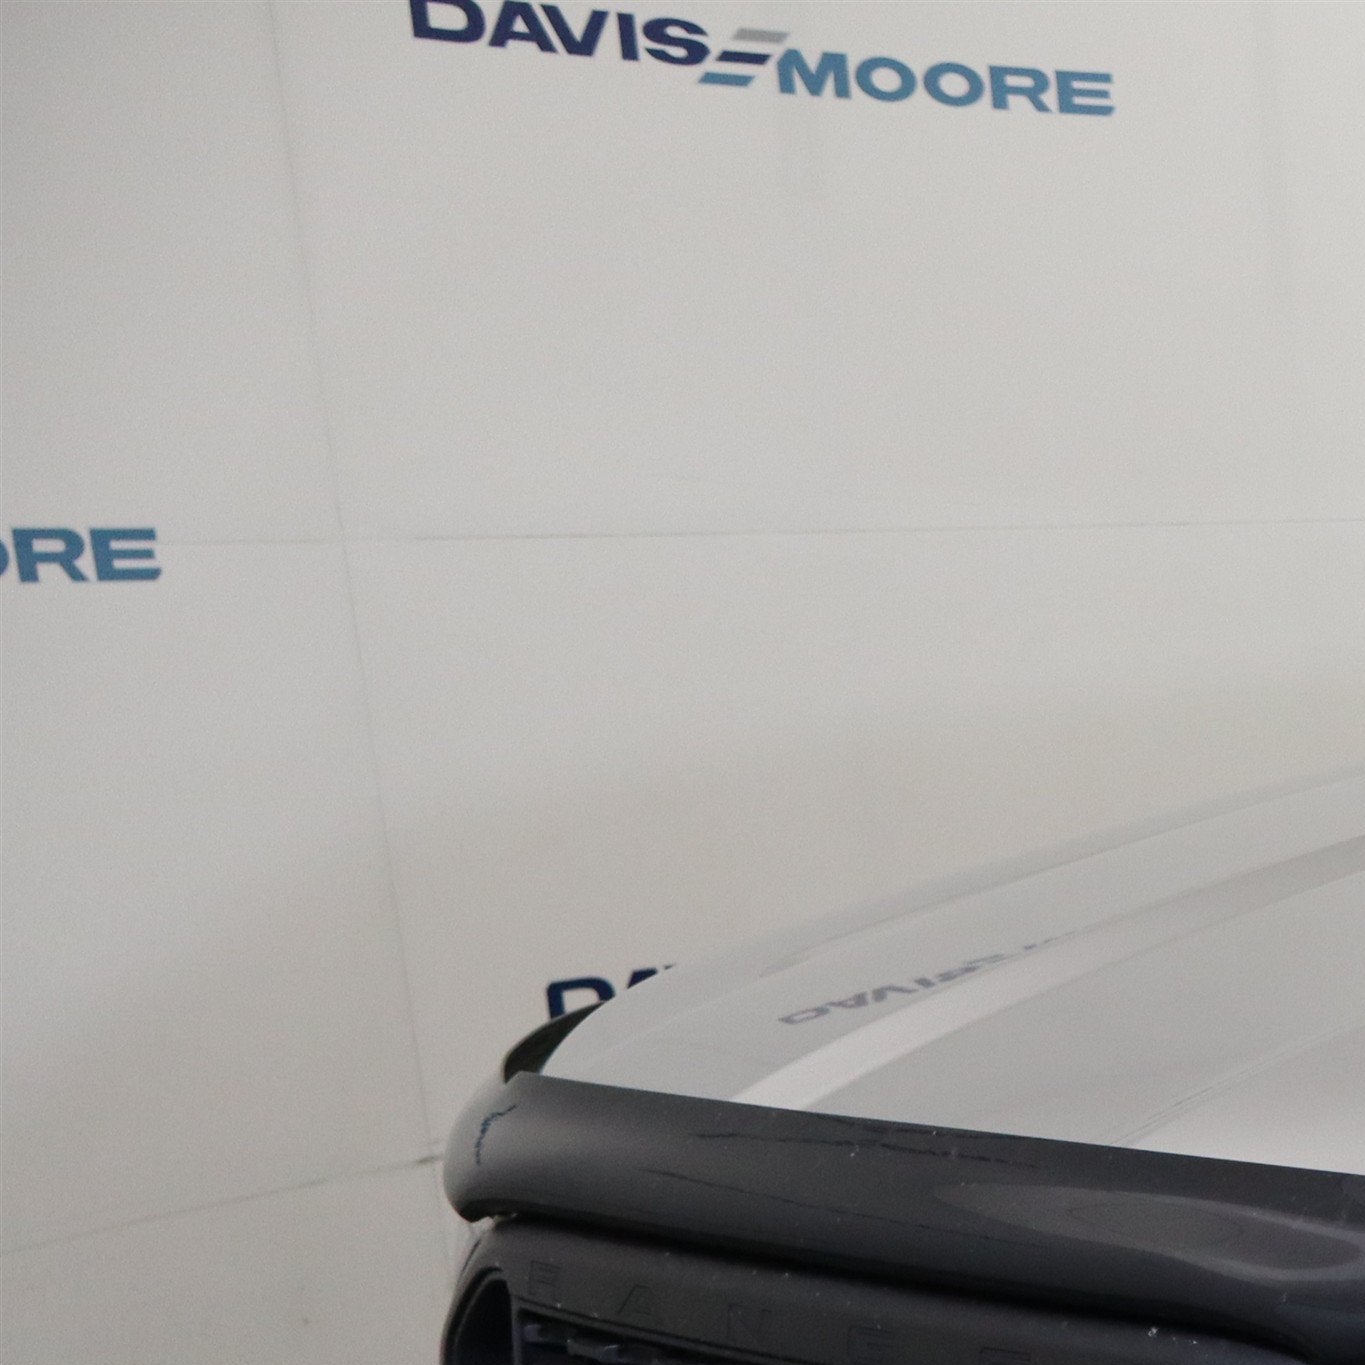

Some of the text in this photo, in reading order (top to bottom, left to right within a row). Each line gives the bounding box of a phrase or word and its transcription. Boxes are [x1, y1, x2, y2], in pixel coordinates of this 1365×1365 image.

[410, 0, 1115, 117] DAVIS MOORE
[0, 527, 163, 584] RE
